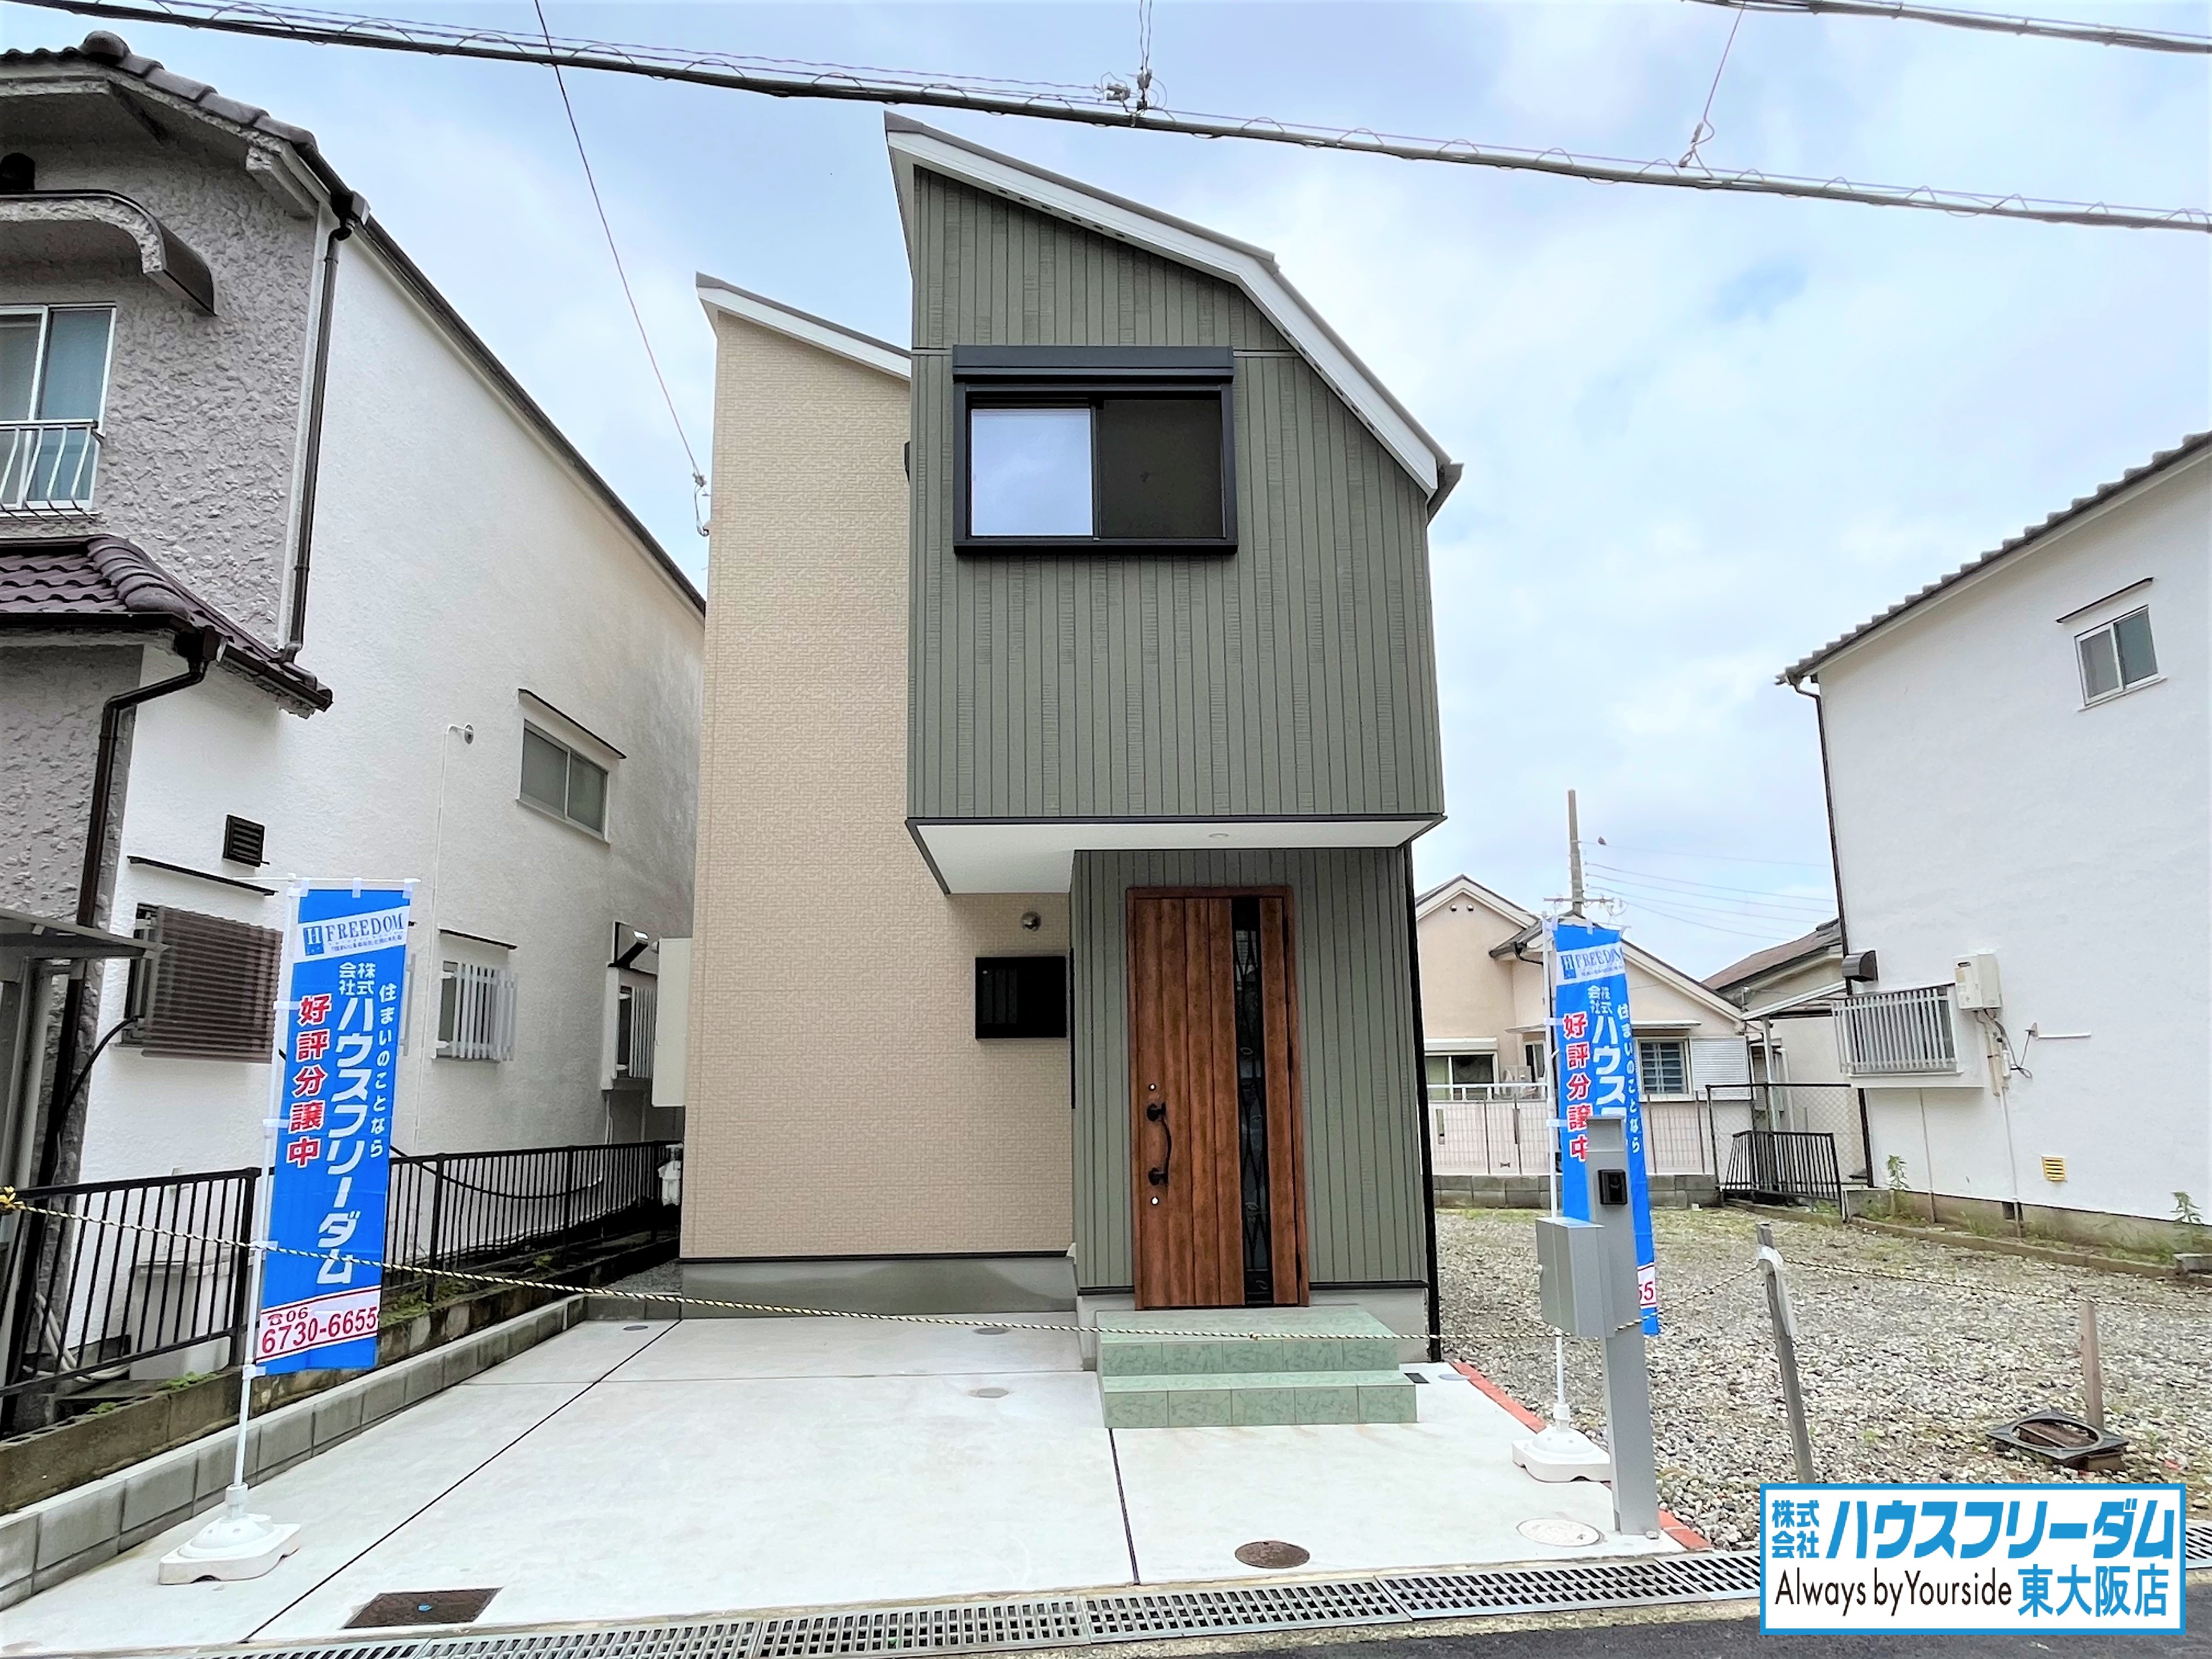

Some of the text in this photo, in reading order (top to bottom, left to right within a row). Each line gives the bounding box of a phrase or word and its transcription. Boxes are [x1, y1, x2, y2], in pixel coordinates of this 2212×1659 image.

[325, 913, 404, 942] FREEDOM
[338, 961, 357, 996] 会社
[357, 962, 376, 995] 株式
[286, 993, 332, 1169] 好評分譲中
[370, 983, 397, 1158] 住まいのことなら
[316, 997, 374, 1284] ハウスフリーダム
[262, 1306, 377, 1354] 6730-6655
[286, 1307, 309, 1323] 06
